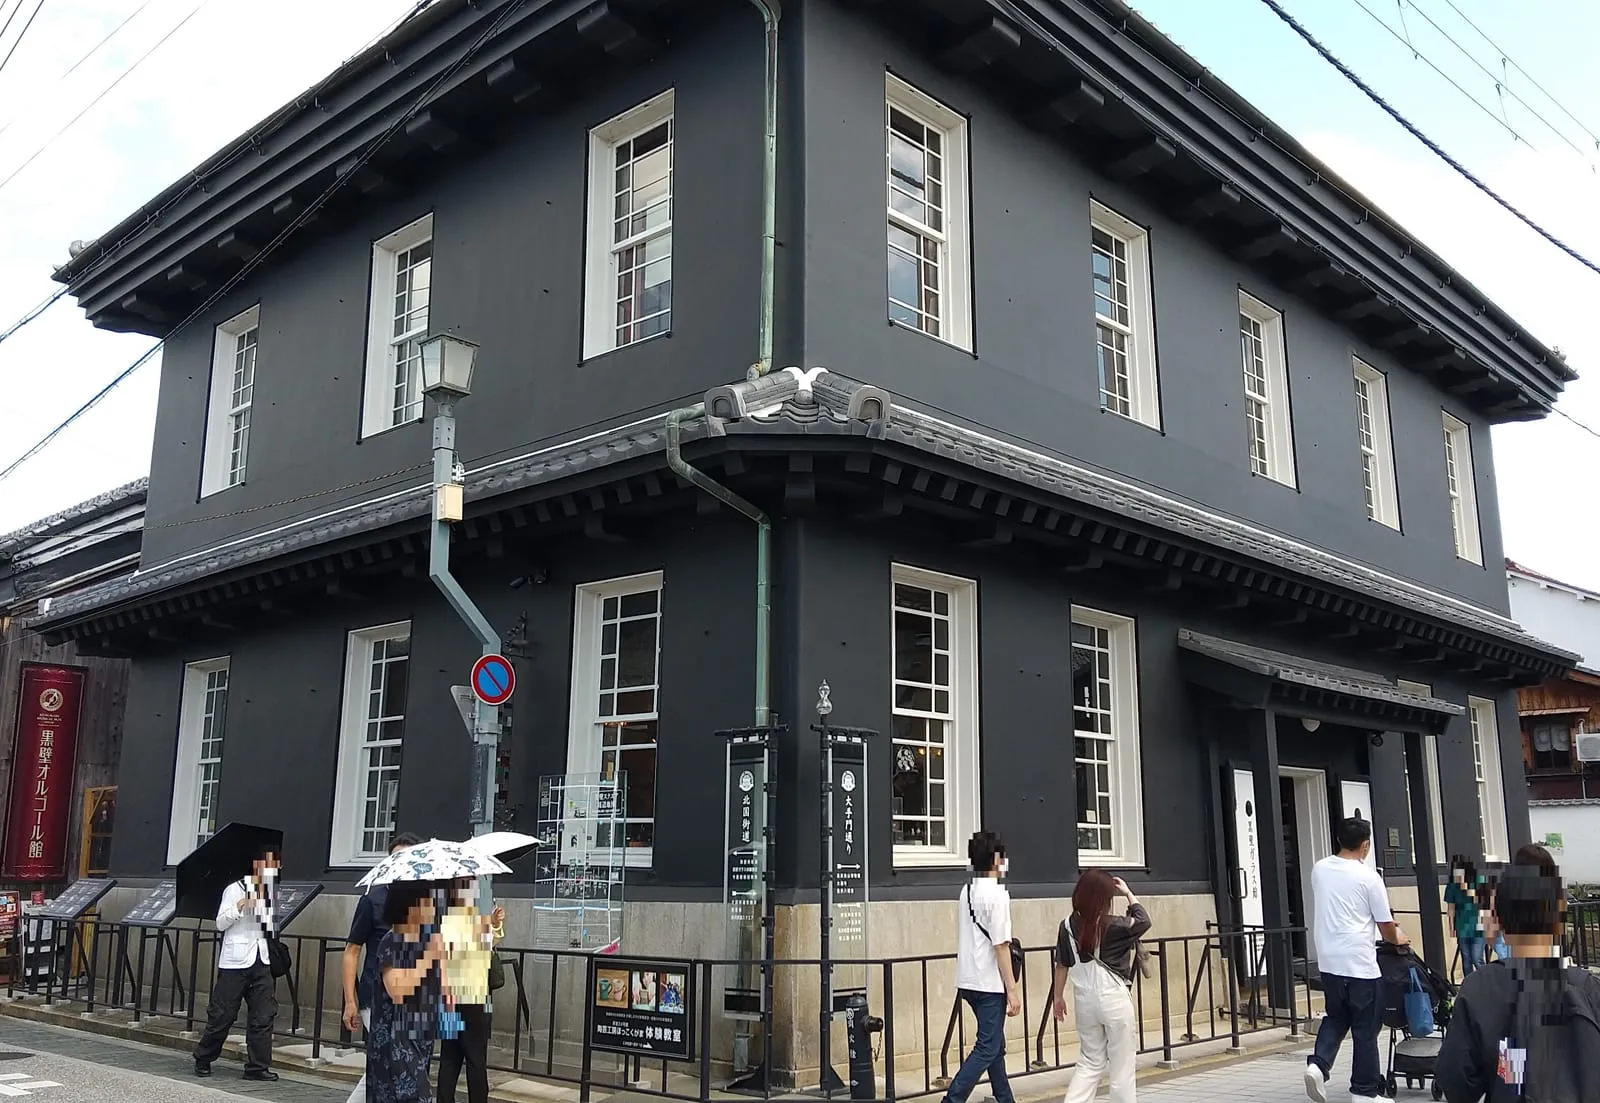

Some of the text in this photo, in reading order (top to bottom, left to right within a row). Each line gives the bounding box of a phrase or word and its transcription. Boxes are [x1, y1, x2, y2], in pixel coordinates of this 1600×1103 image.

[28, 729, 54, 858] 黒壁オルゴール館
[844, 795, 853, 855] 大手門通り
[645, 1025, 682, 1042] 体験教室
